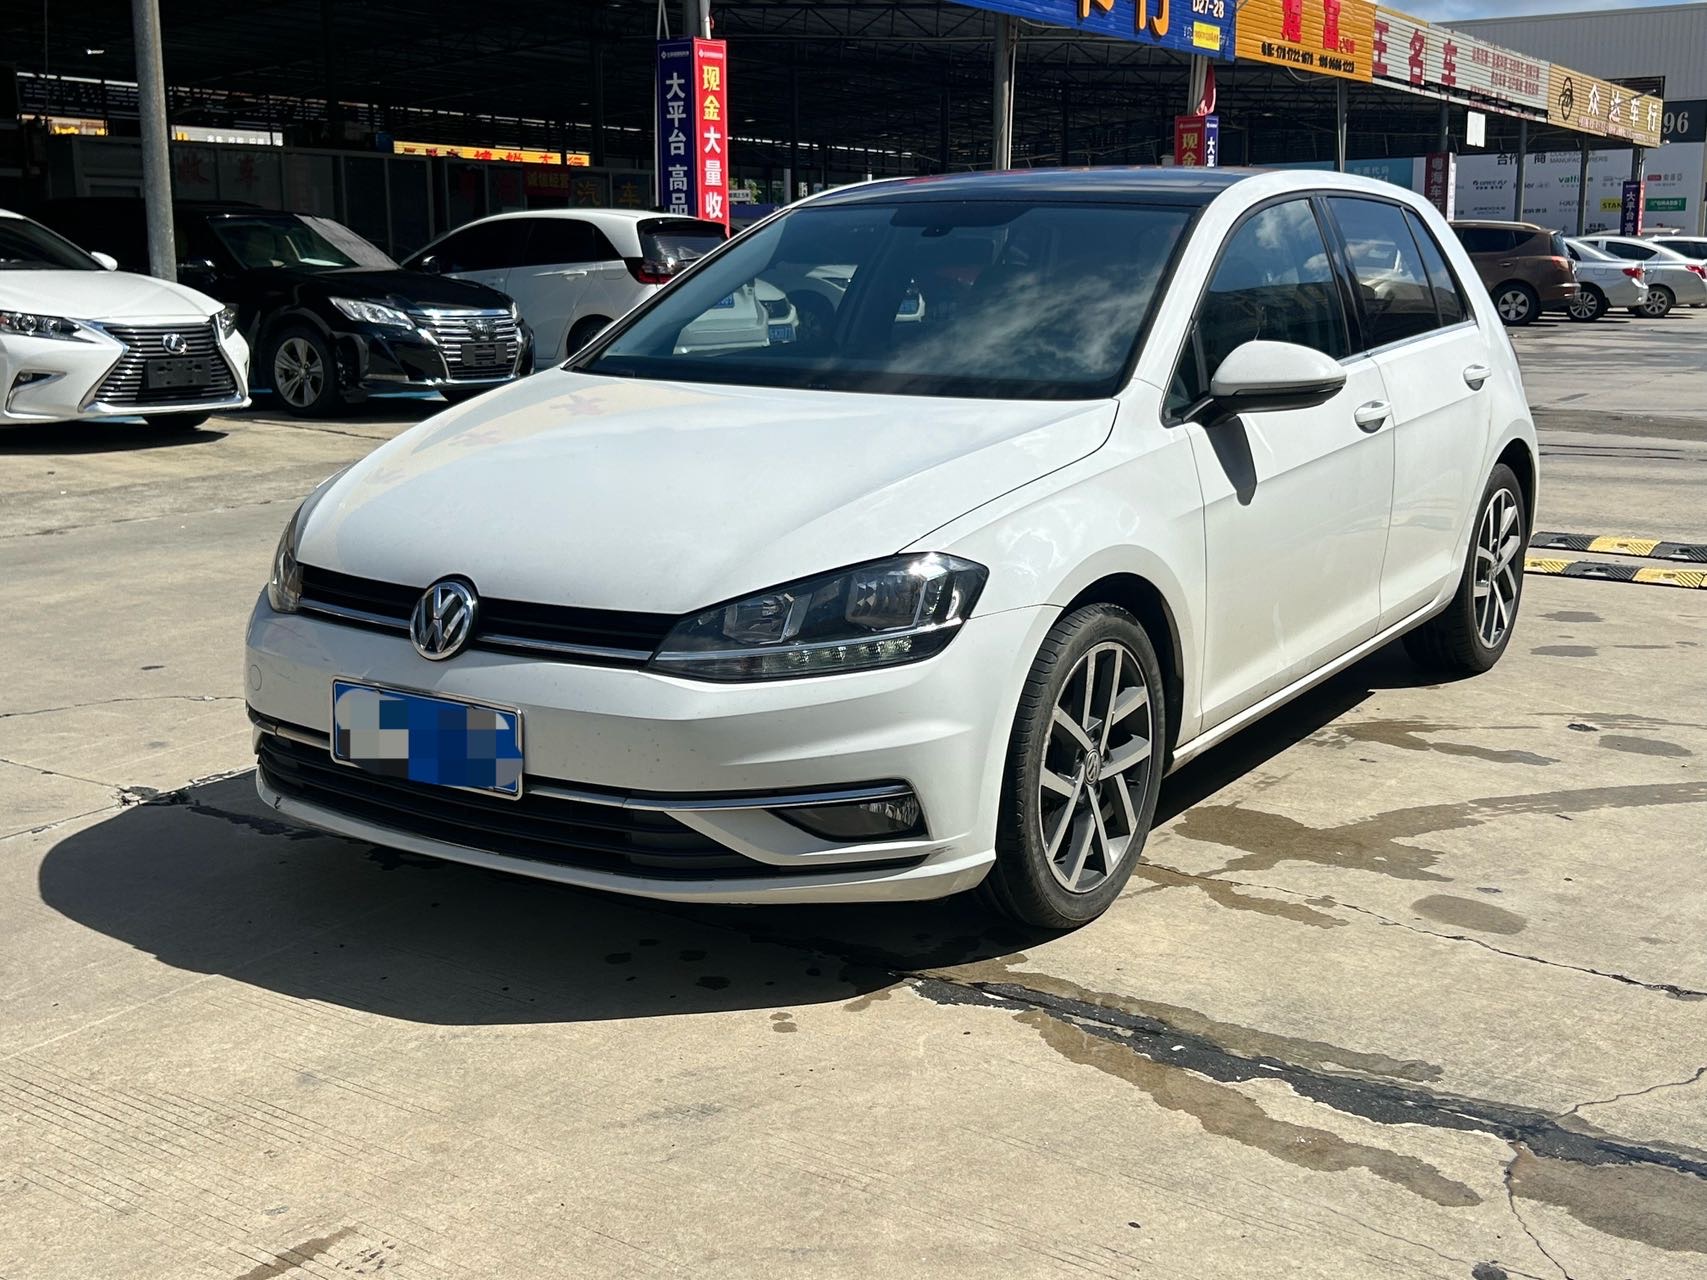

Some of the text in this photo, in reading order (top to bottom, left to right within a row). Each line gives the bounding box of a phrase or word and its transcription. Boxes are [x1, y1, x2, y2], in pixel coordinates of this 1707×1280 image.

[666, 72, 687, 156] 大平台
[702, 65, 723, 219] 现金大量收
